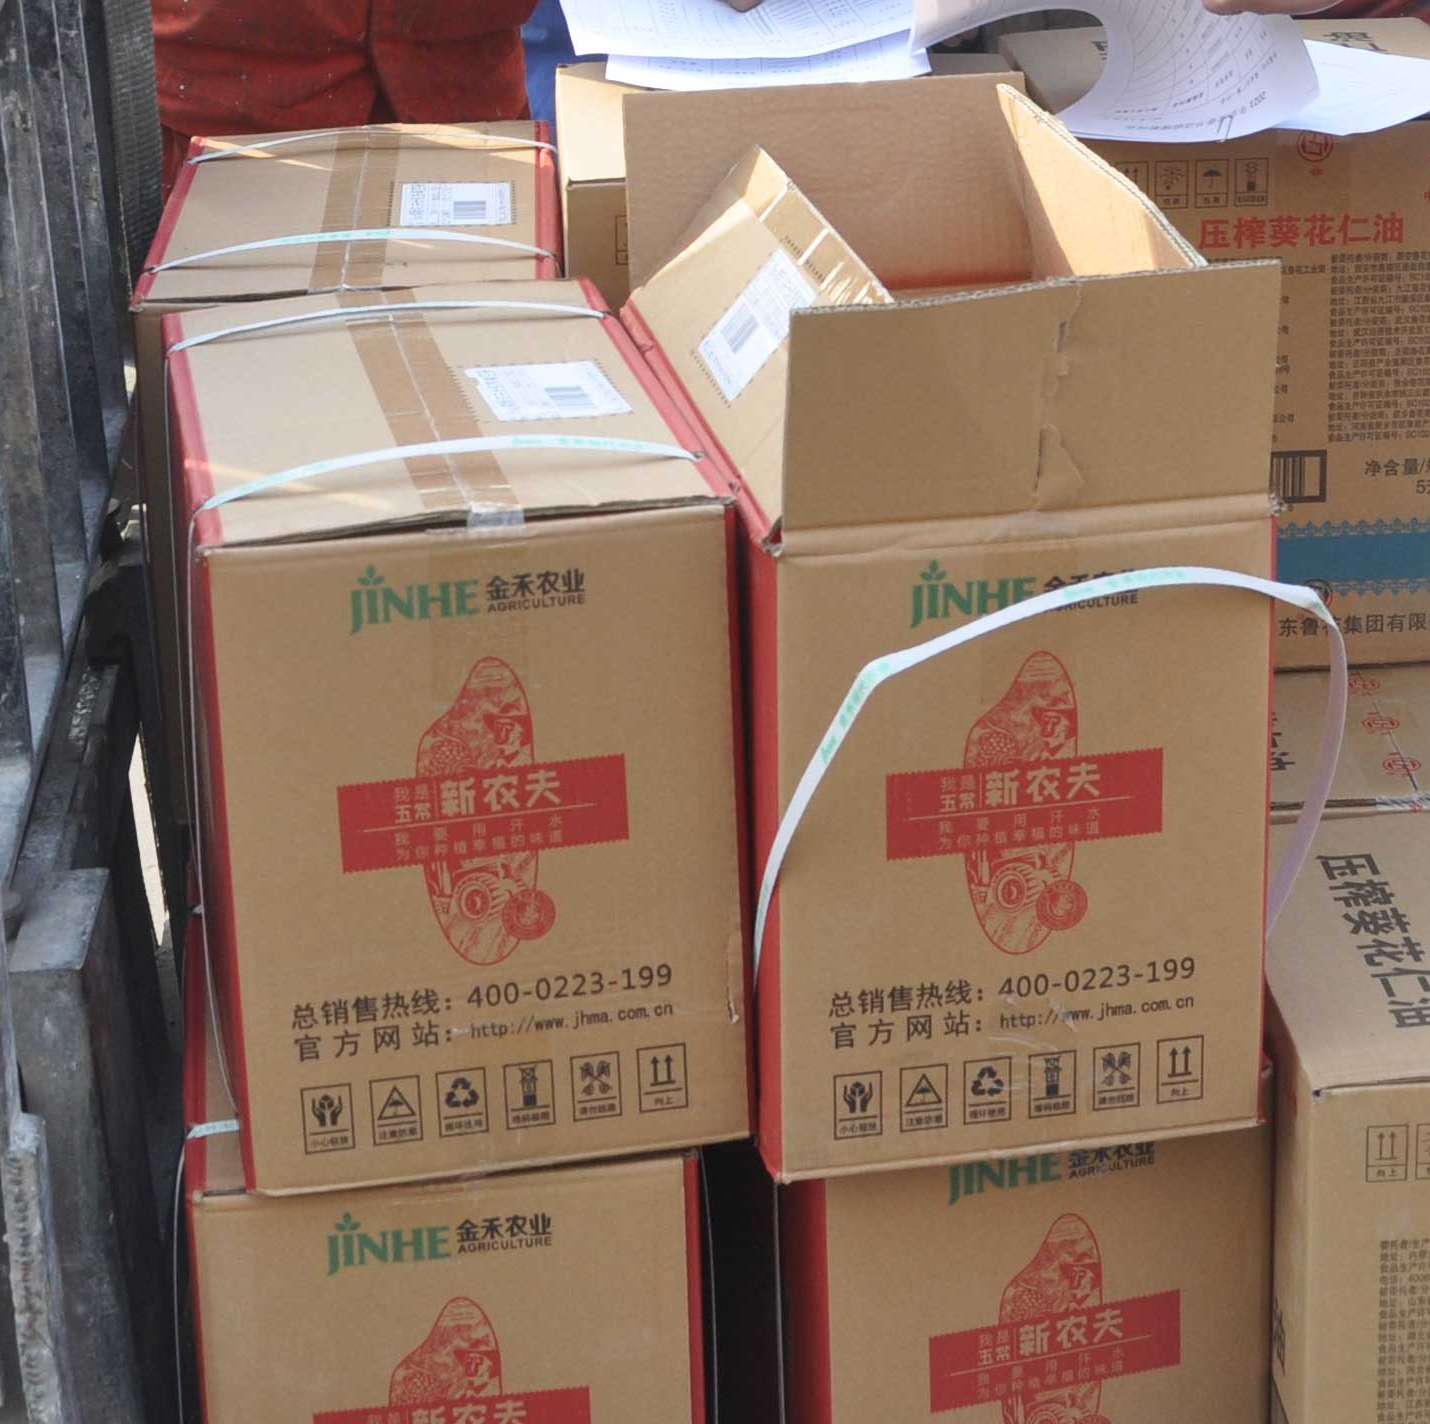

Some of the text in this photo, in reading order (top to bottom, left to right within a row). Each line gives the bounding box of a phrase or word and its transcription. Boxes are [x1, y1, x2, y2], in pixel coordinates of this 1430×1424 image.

[1197, 213, 1404, 250] 压榨葵花仁油
[350, 564, 480, 635] JINHE
[486, 568, 585, 601] 金禾农业
[487, 594, 586, 613] AGRICULTURE
[440, 769, 561, 817] 新农夫
[940, 792, 976, 813] 五常
[985, 762, 1100, 806] 新农夫
[394, 801, 431, 824] 五常
[467, 963, 673, 1010] 400-0223-199
[998, 956, 1196, 1001] 400-0223-199
[471, 1002, 673, 1040] http://www.jhma.com.cn
[1069, 1153, 1155, 1179] AGRICULTURE
[327, 1211, 452, 1276] JINHE
[457, 1213, 552, 1242] 金禾农业
[457, 1235, 552, 1254] AGRICULTURE
[1019, 1308, 1124, 1355] 新农夫
